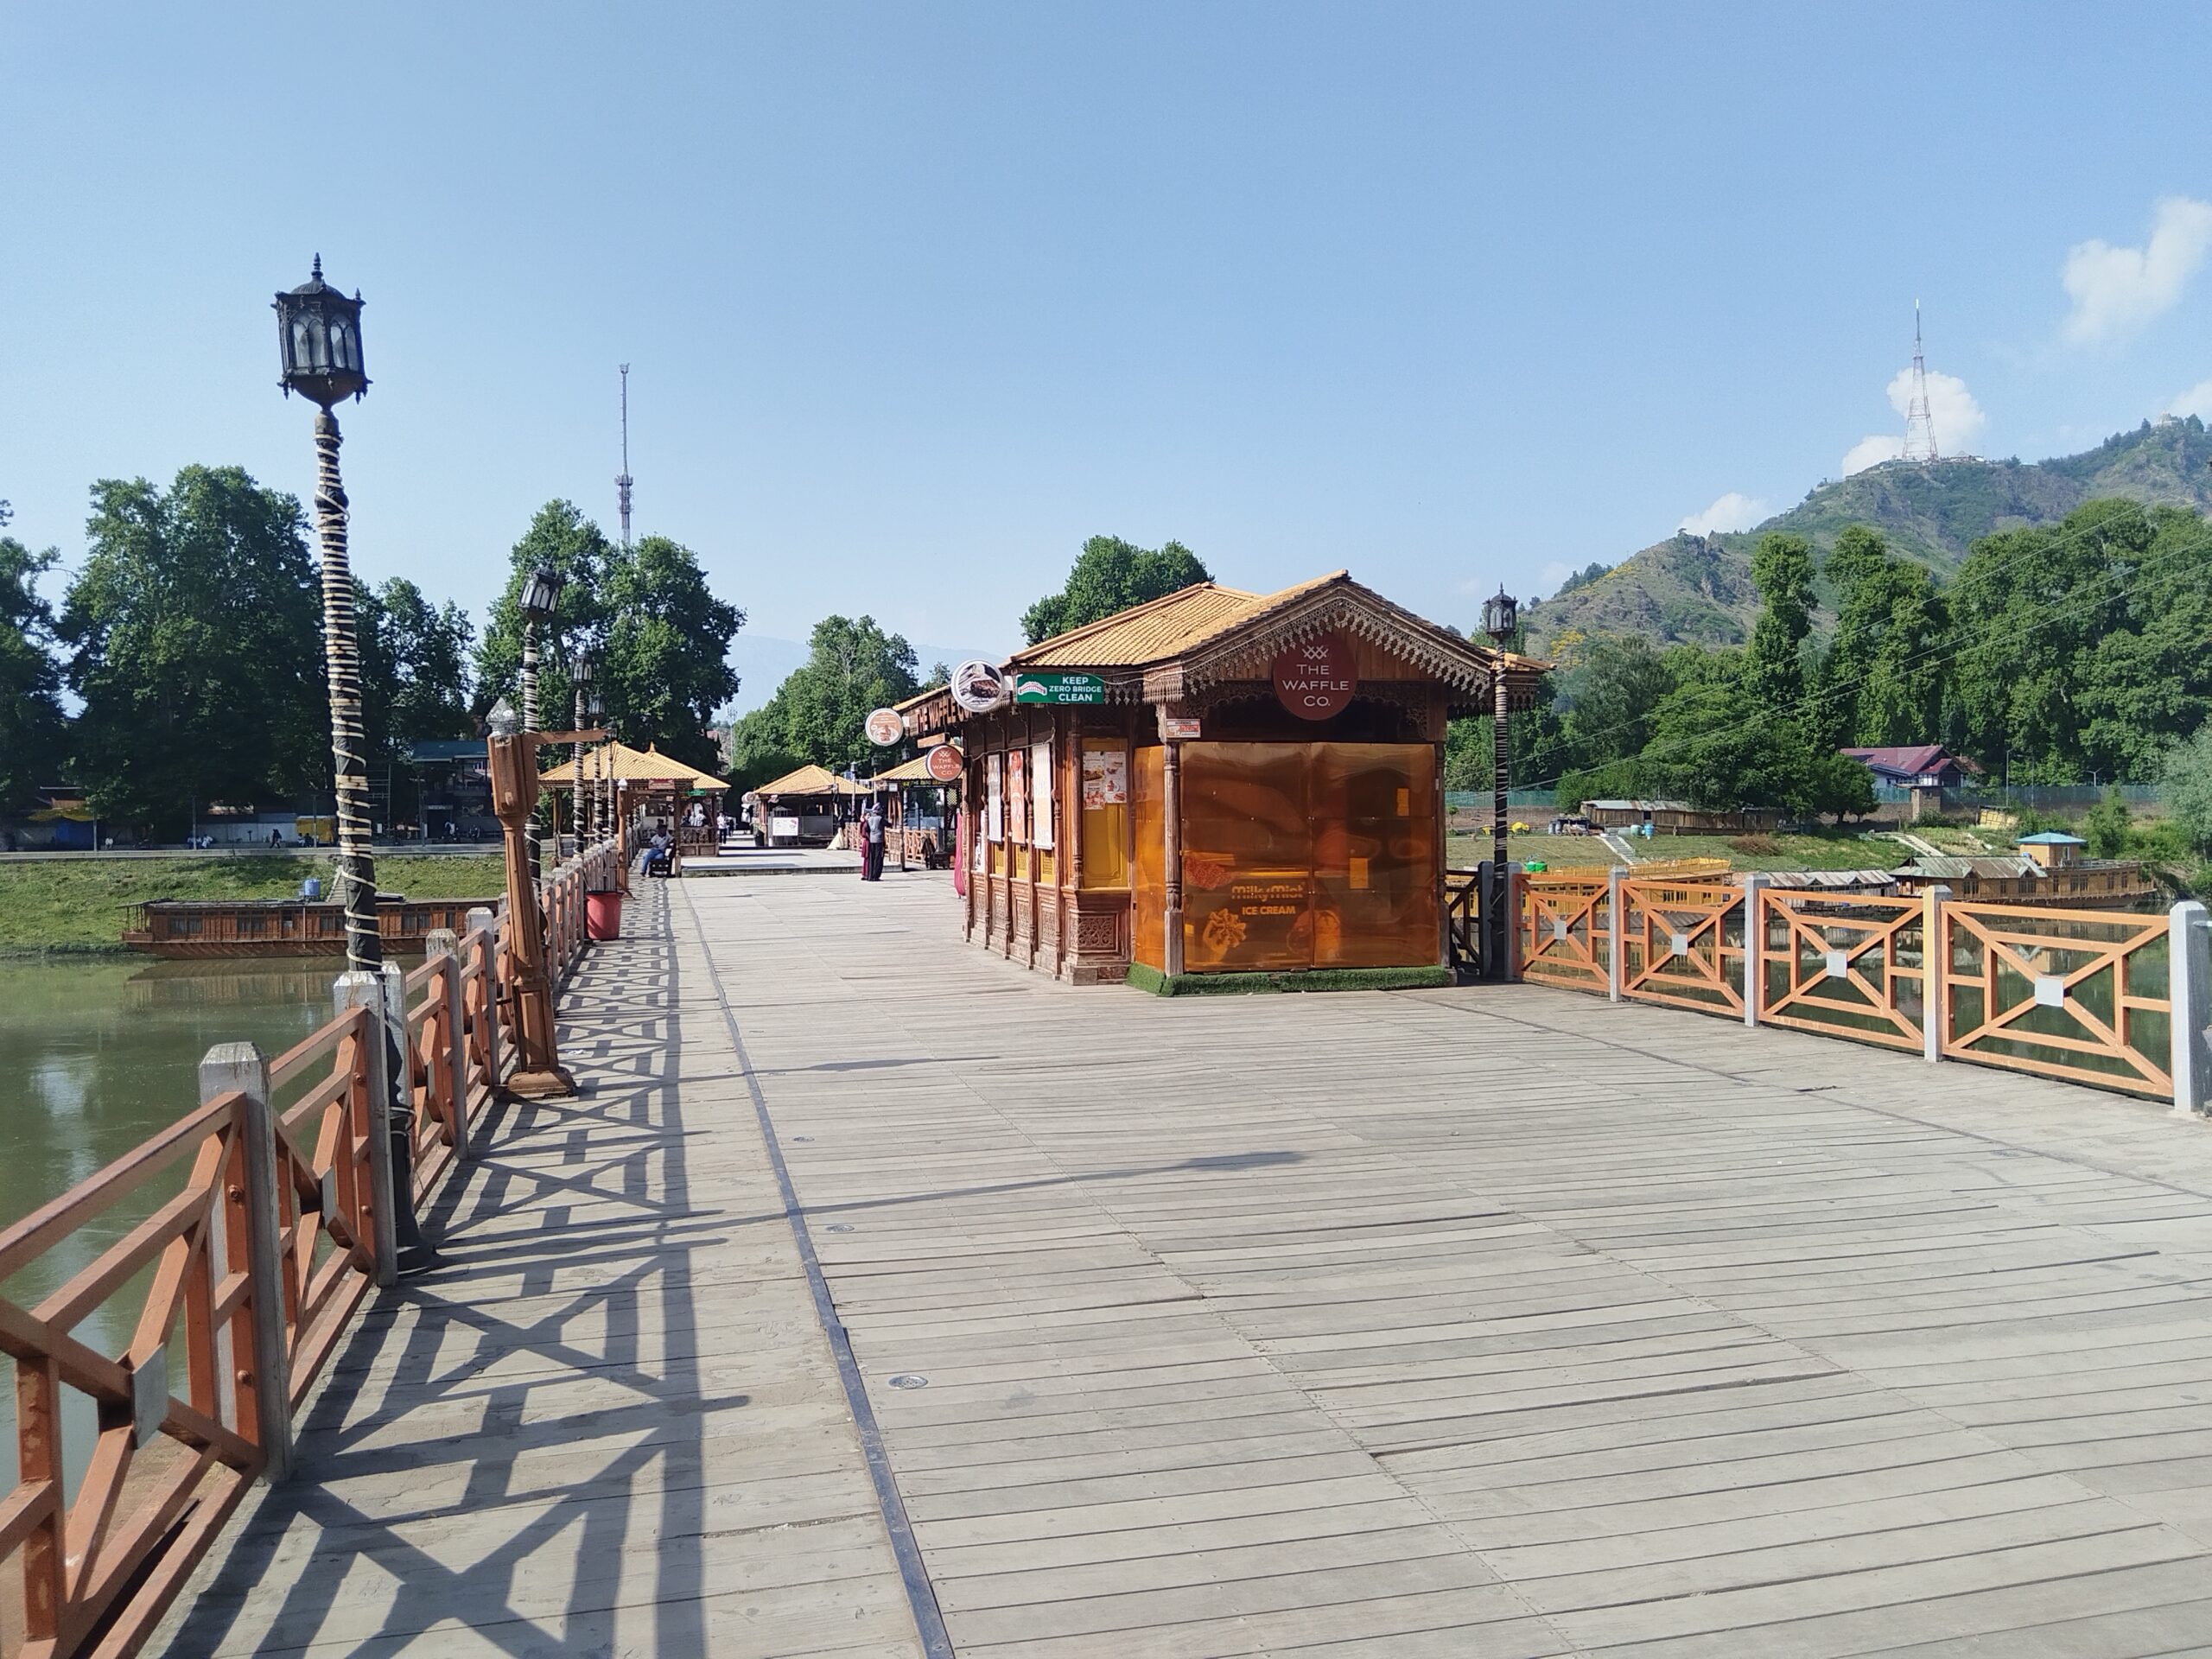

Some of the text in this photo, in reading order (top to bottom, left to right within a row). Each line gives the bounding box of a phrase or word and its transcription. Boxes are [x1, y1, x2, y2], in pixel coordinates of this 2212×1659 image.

[1296, 664, 1330, 675] THE
[1282, 679, 1350, 690] WAFFLE
[1058, 693, 1093, 702] CLEAN
[1303, 695, 1332, 707] CO.
[1242, 906, 1296, 915] ICE CREAM
